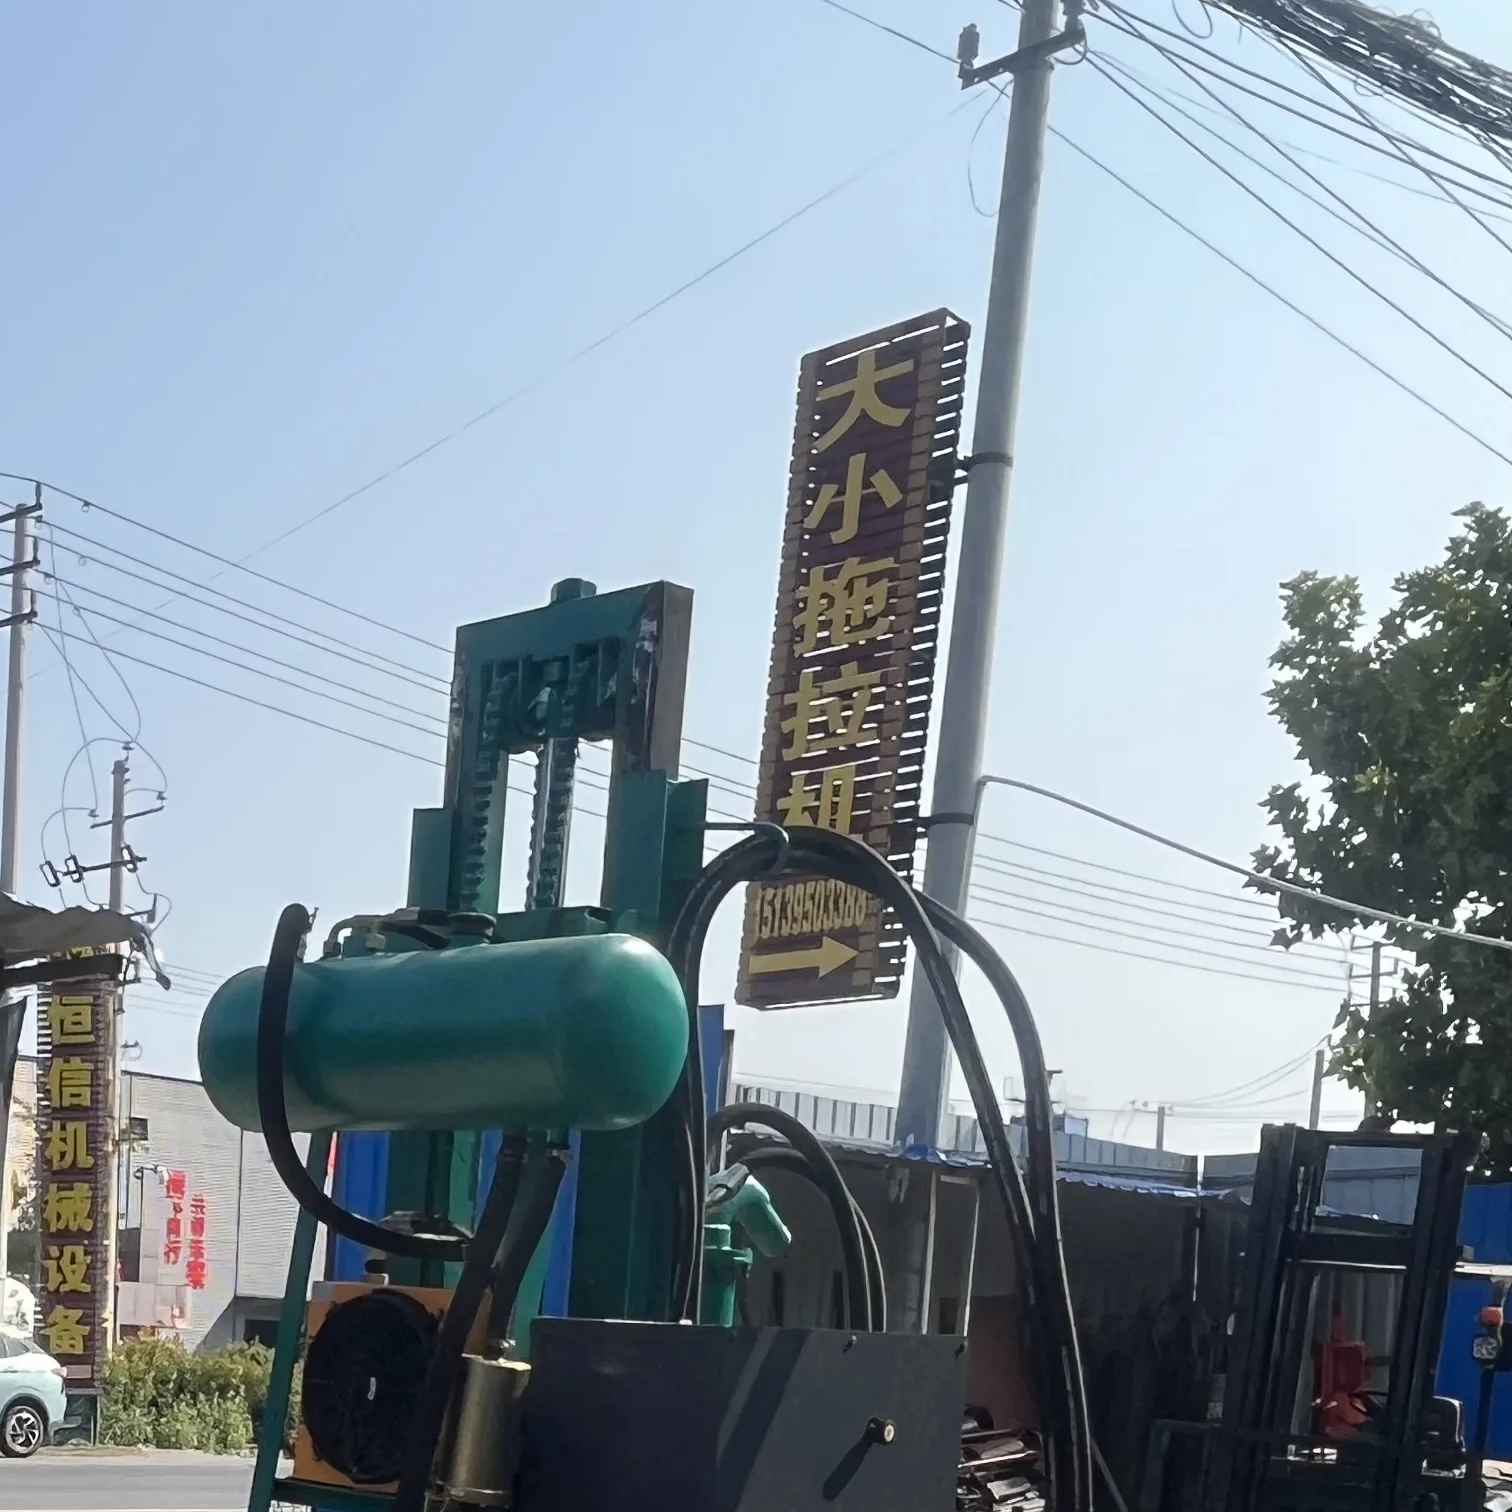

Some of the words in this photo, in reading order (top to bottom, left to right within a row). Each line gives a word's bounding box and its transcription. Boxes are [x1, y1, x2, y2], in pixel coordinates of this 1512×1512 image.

[776, 350, 915, 834] 大小拖拉机
[43, 946, 95, 1356] 恒信机械设备
